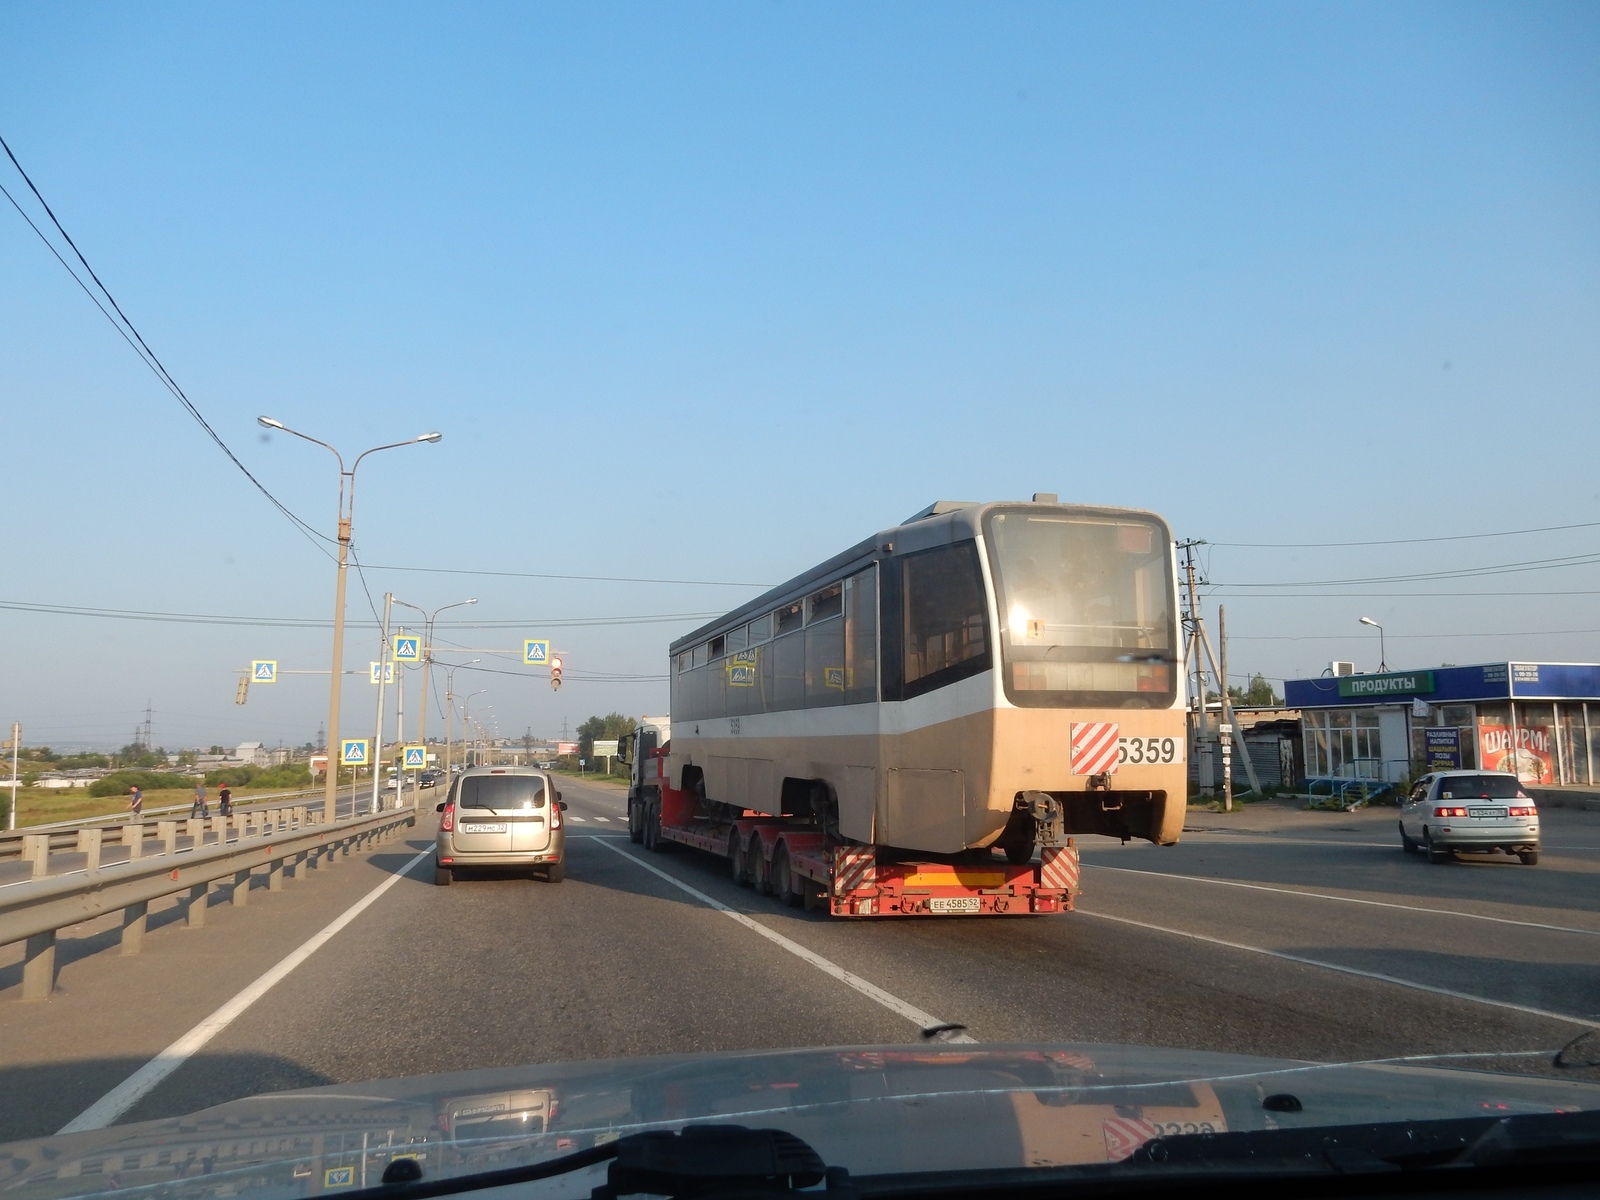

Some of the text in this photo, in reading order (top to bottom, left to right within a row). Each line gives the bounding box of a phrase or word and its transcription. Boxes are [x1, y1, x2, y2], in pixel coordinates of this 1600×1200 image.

[1352, 677, 1416, 693] ПРОДУКТЫ
[1119, 738, 1175, 763] 5359
[946, 899, 967, 908] 4585
